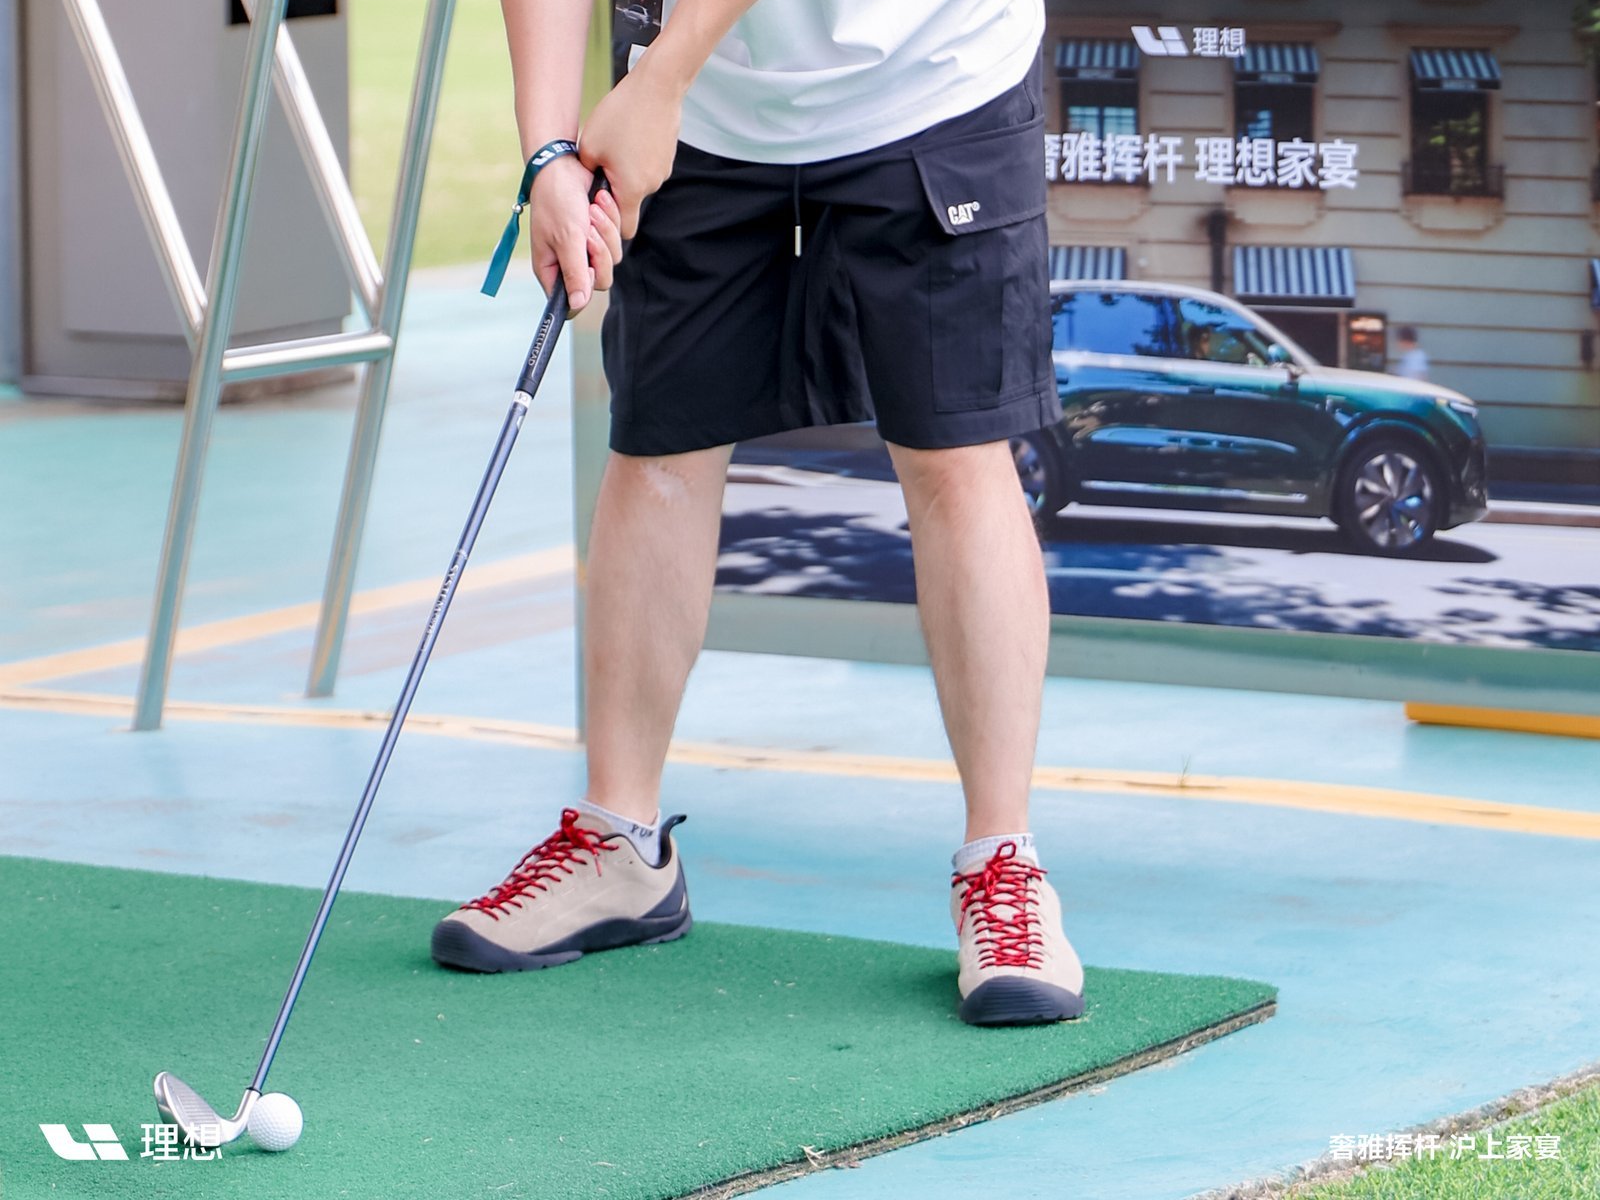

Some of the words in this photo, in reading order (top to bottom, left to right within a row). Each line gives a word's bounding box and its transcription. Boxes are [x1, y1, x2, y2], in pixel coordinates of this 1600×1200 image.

[1193, 26, 1247, 57] 理想
[1194, 136, 1359, 190] 理想家宴
